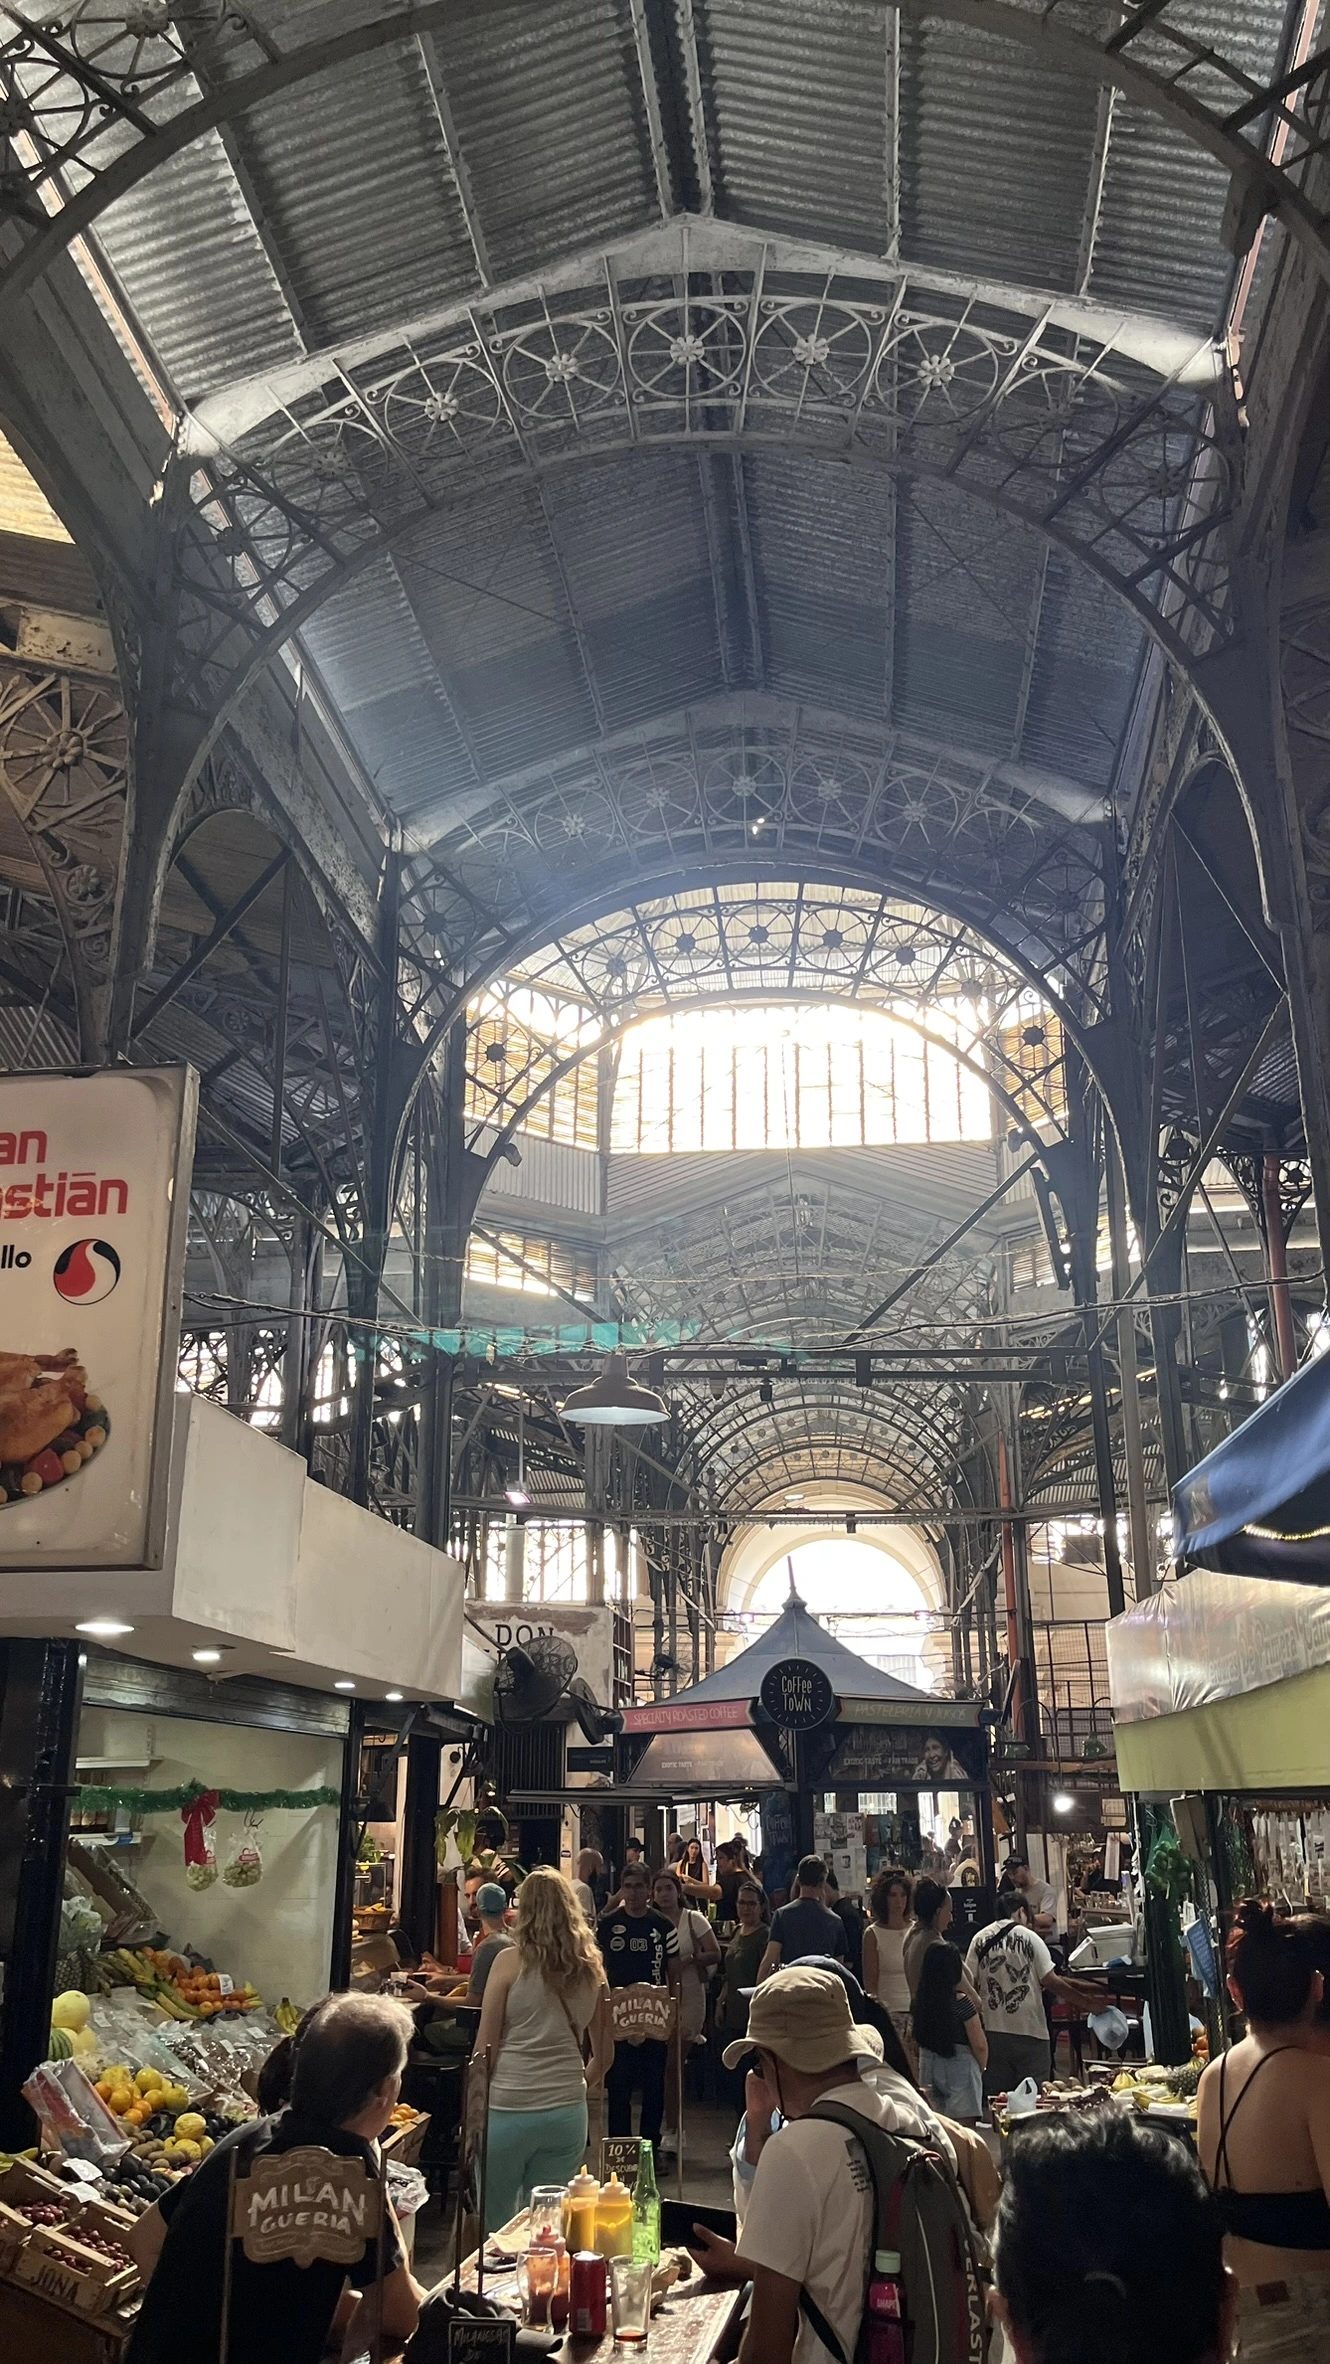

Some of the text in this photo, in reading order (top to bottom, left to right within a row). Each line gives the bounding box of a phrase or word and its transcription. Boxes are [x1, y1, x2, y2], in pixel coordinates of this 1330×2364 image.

[633, 1705, 739, 1726] SPECIALTY ROASTED COFFEE
[629, 1937, 648, 1952] 03
[612, 1999, 671, 2024] MILAN
[618, 2012, 667, 2029] GUERIA
[247, 2181, 367, 2228] MILAN
[259, 2211, 351, 2235] GUERIA
[963, 2238, 984, 2364] ERLAST
